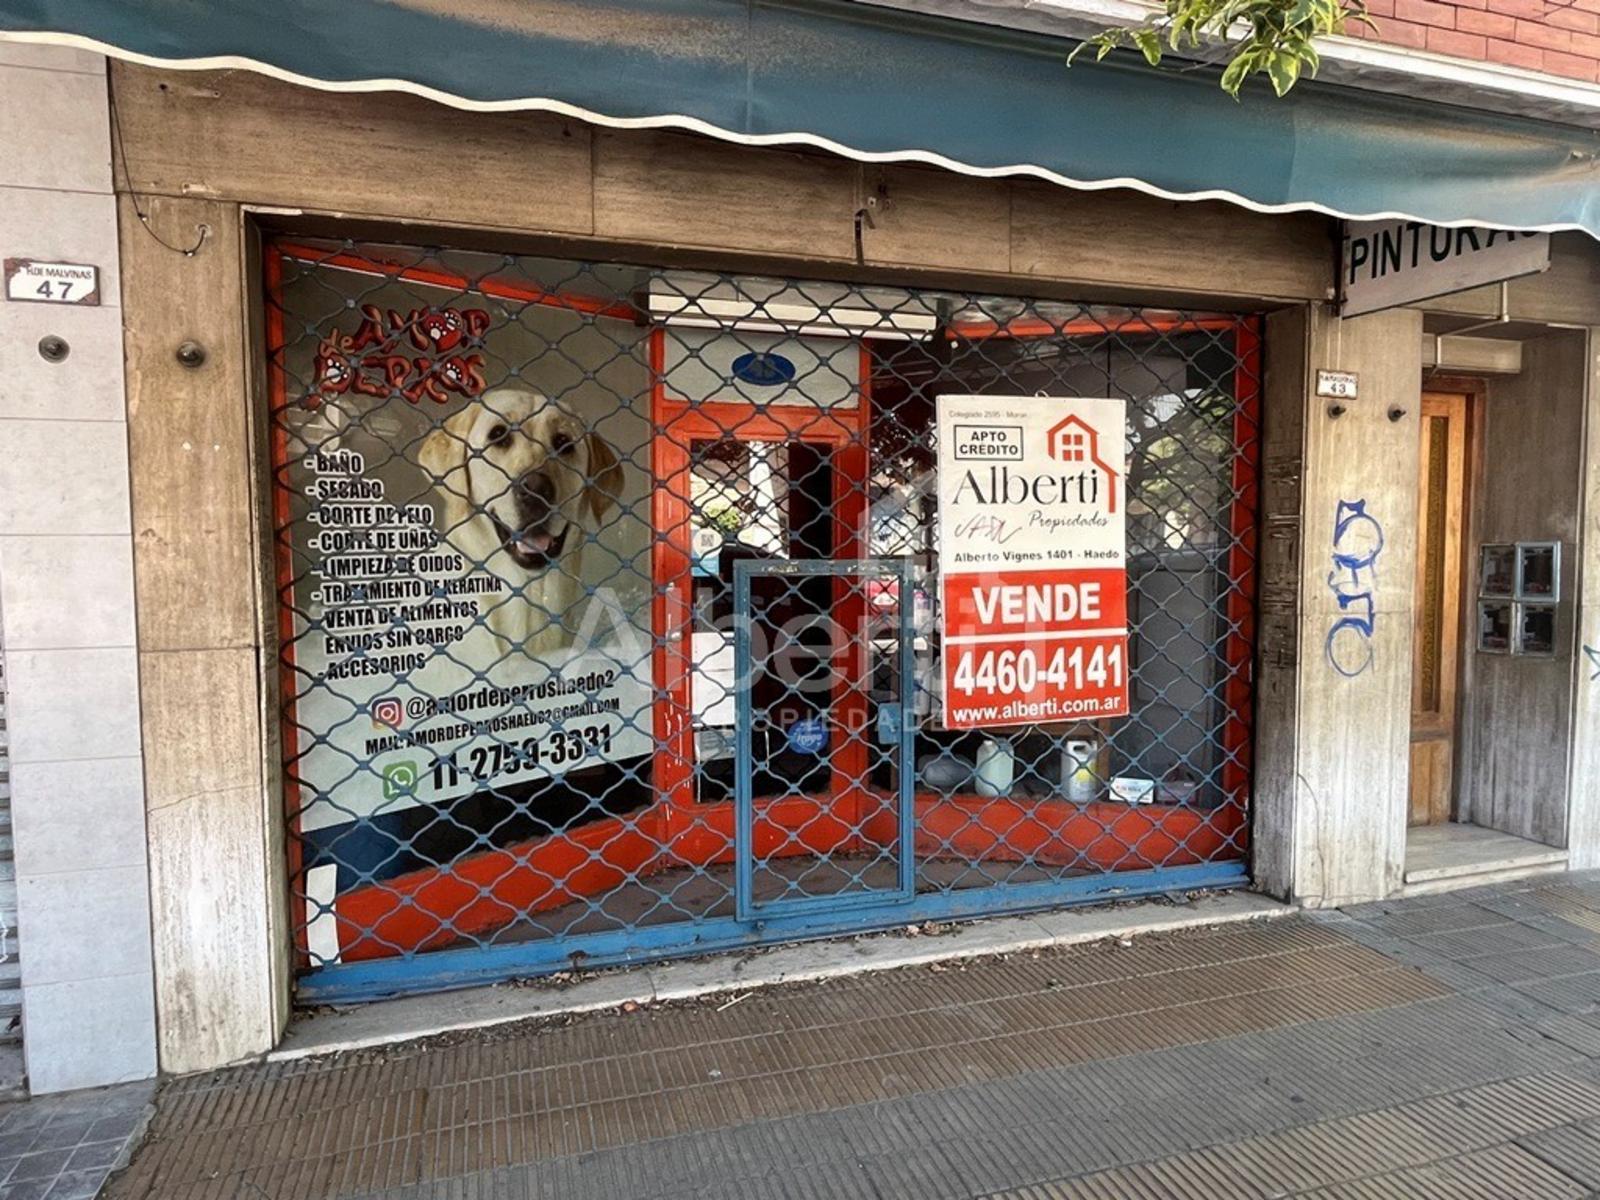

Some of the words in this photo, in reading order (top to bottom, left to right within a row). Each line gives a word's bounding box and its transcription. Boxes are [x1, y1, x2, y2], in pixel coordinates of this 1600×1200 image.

[1350, 223, 1538, 285] PINTUR
[46, 267, 92, 280] MALVINAS
[36, 280, 74, 299] 47
[1330, 383, 1346, 395] 43
[971, 431, 1007, 442] APTO
[317, 451, 362, 473] BAÑO
[318, 480, 382, 499] SECADO
[952, 466, 1098, 505] Alberti
[320, 506, 372, 525] CORTE
[375, 506, 396, 524] DE
[397, 506, 432, 525] PELO
[1028, 510, 1109, 534] Propiedades
[376, 532, 396, 549] DE
[399, 528, 439, 549] UÑAS
[419, 555, 463, 571] OIDOS
[954, 552, 1000, 563] Alberto
[1002, 551, 1042, 563] Vignes
[1047, 551, 1073, 560] 1401
[1084, 550, 1119, 560] Haedo
[443, 575, 502, 595] KERATINA
[325, 609, 374, 629] VENTA
[378, 607, 396, 625] DE
[399, 600, 479, 623] ALIMENTOS
[972, 582, 1101, 625] VENDE
[325, 631, 385, 655] ENVIOS
[387, 628, 412, 648] SIN
[415, 624, 464, 646] CARGO
[327, 652, 426, 680] ACCESORIOS
[953, 644, 1122, 696] 4460-4141
[952, 695, 1121, 723] www.alberti.com.ar
[427, 723, 612, 790] 11-2759-3331
